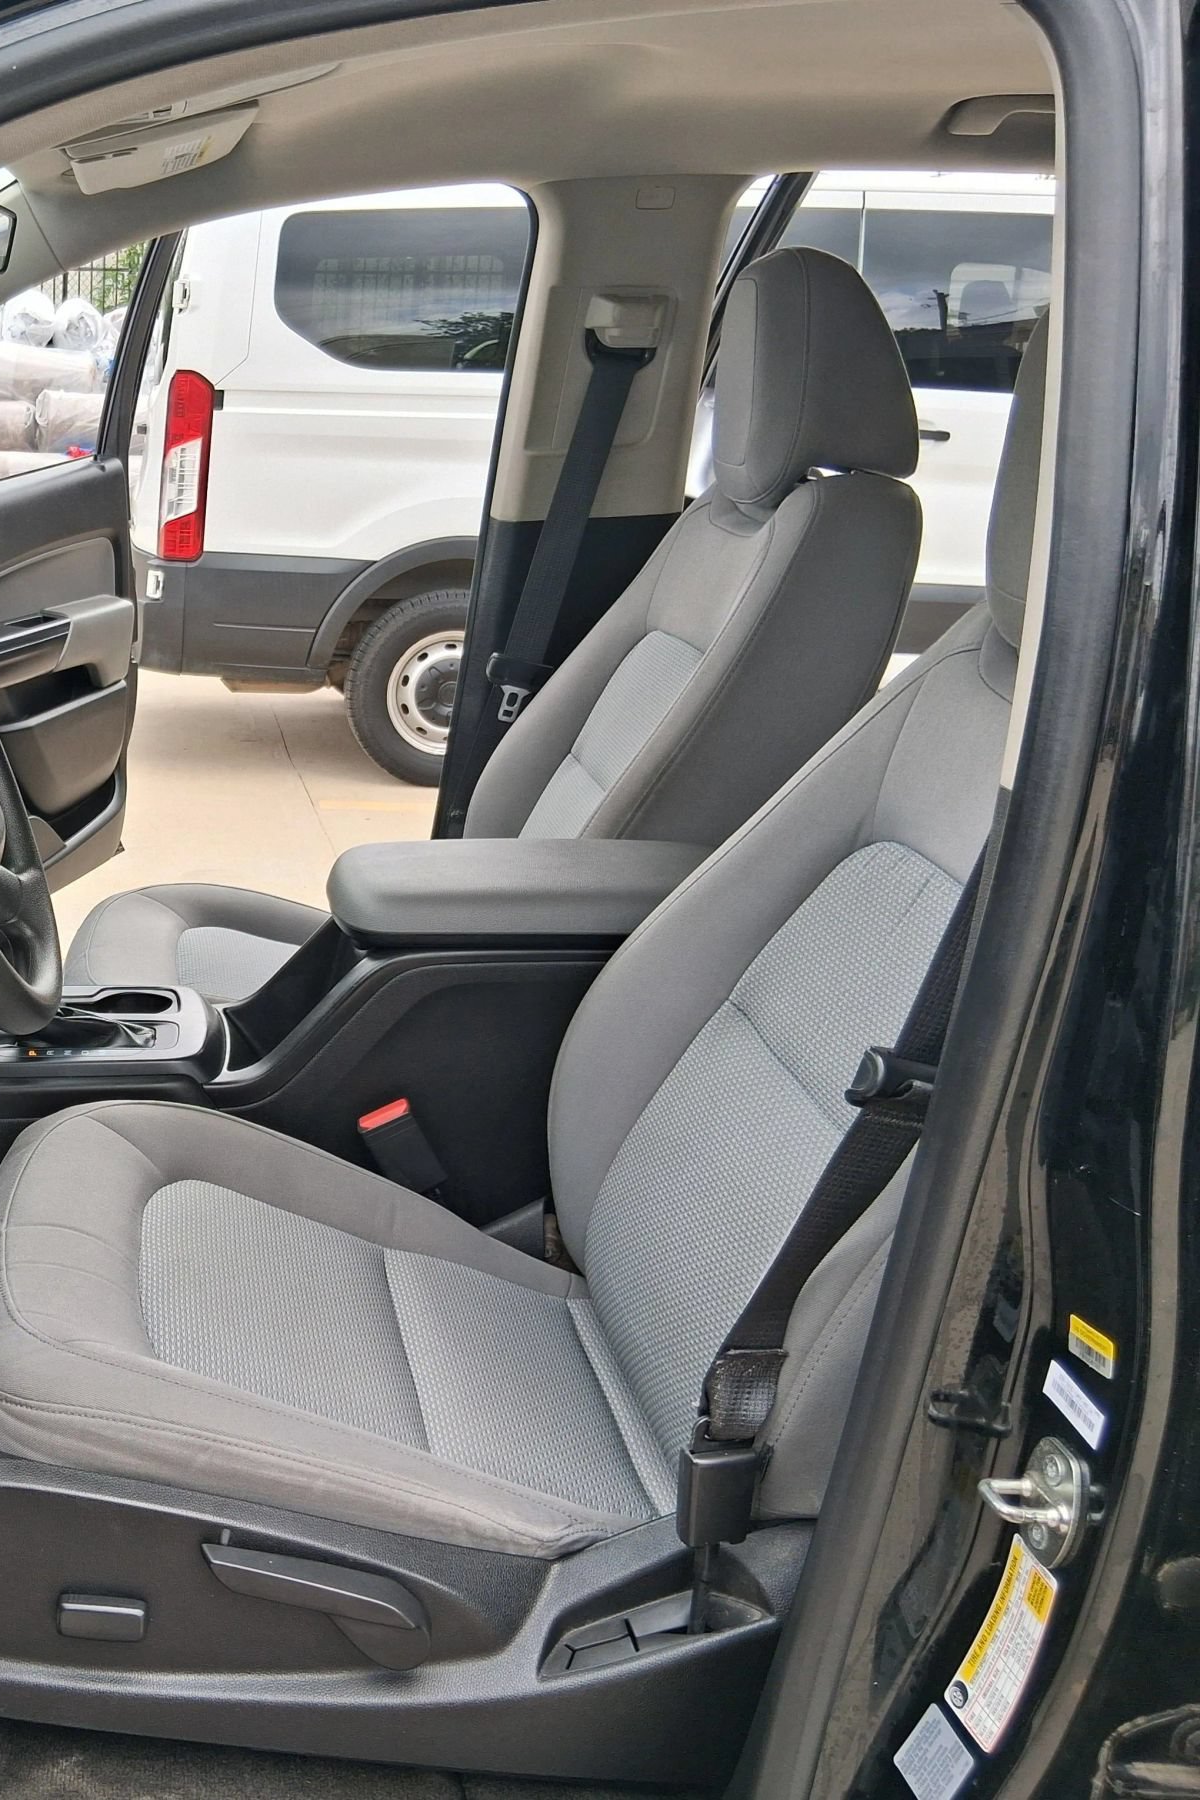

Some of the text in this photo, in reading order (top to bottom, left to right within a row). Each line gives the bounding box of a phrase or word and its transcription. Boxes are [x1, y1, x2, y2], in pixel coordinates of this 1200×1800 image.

[968, 1557, 1018, 1667] TIRE AND LOADING INFORMATION
